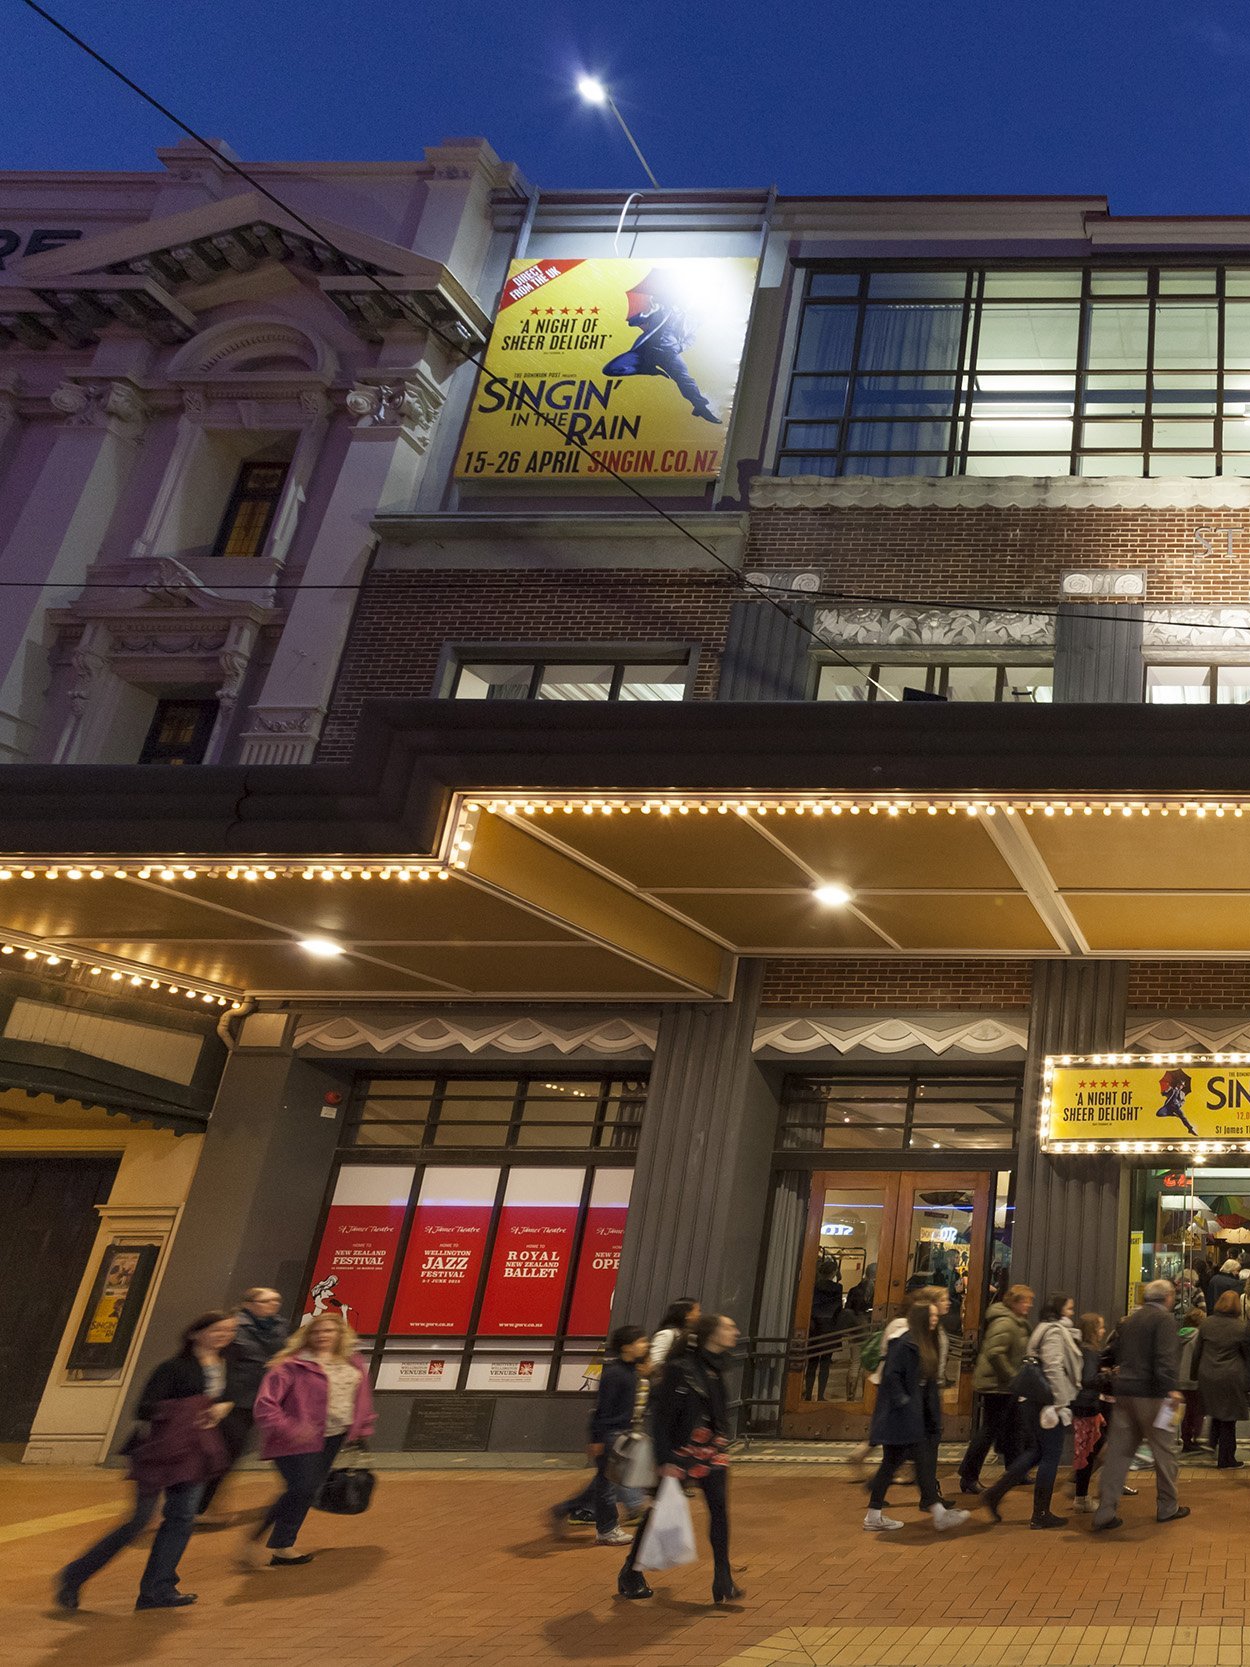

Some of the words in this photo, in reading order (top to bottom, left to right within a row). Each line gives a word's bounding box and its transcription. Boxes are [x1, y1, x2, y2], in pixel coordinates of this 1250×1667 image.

[512, 265, 544, 286] DIRECT
[509, 282, 534, 300] FROM
[532, 274, 550, 288] THE
[545, 266, 561, 278] UK
[535, 319, 578, 334] NIGHT
[582, 318, 599, 333] OF
[501, 335, 545, 350] SHEER
[511, 413, 530, 426] IN
[533, 412, 568, 426] THE
[565, 412, 641, 446] RAIN
[464, 451, 520, 473] 15-26
[525, 451, 580, 473] APRIL
[587, 450, 718, 473] SINGIN.CO.NZ
[1194, 526, 1245, 559] ST
[1088, 1092, 1117, 1105] NIGHT
[1121, 1091, 1133, 1105] OF
[1063, 1108, 1094, 1121] SHEER
[1215, 1126, 1222, 1134] St
[1224, 1126, 1243, 1134] James
[332, 1257, 384, 1265] FESTIVAL
[507, 1251, 560, 1261] ROYAL
[422, 1257, 469, 1270] JAZZ
[503, 1268, 558, 1278] BALLET
